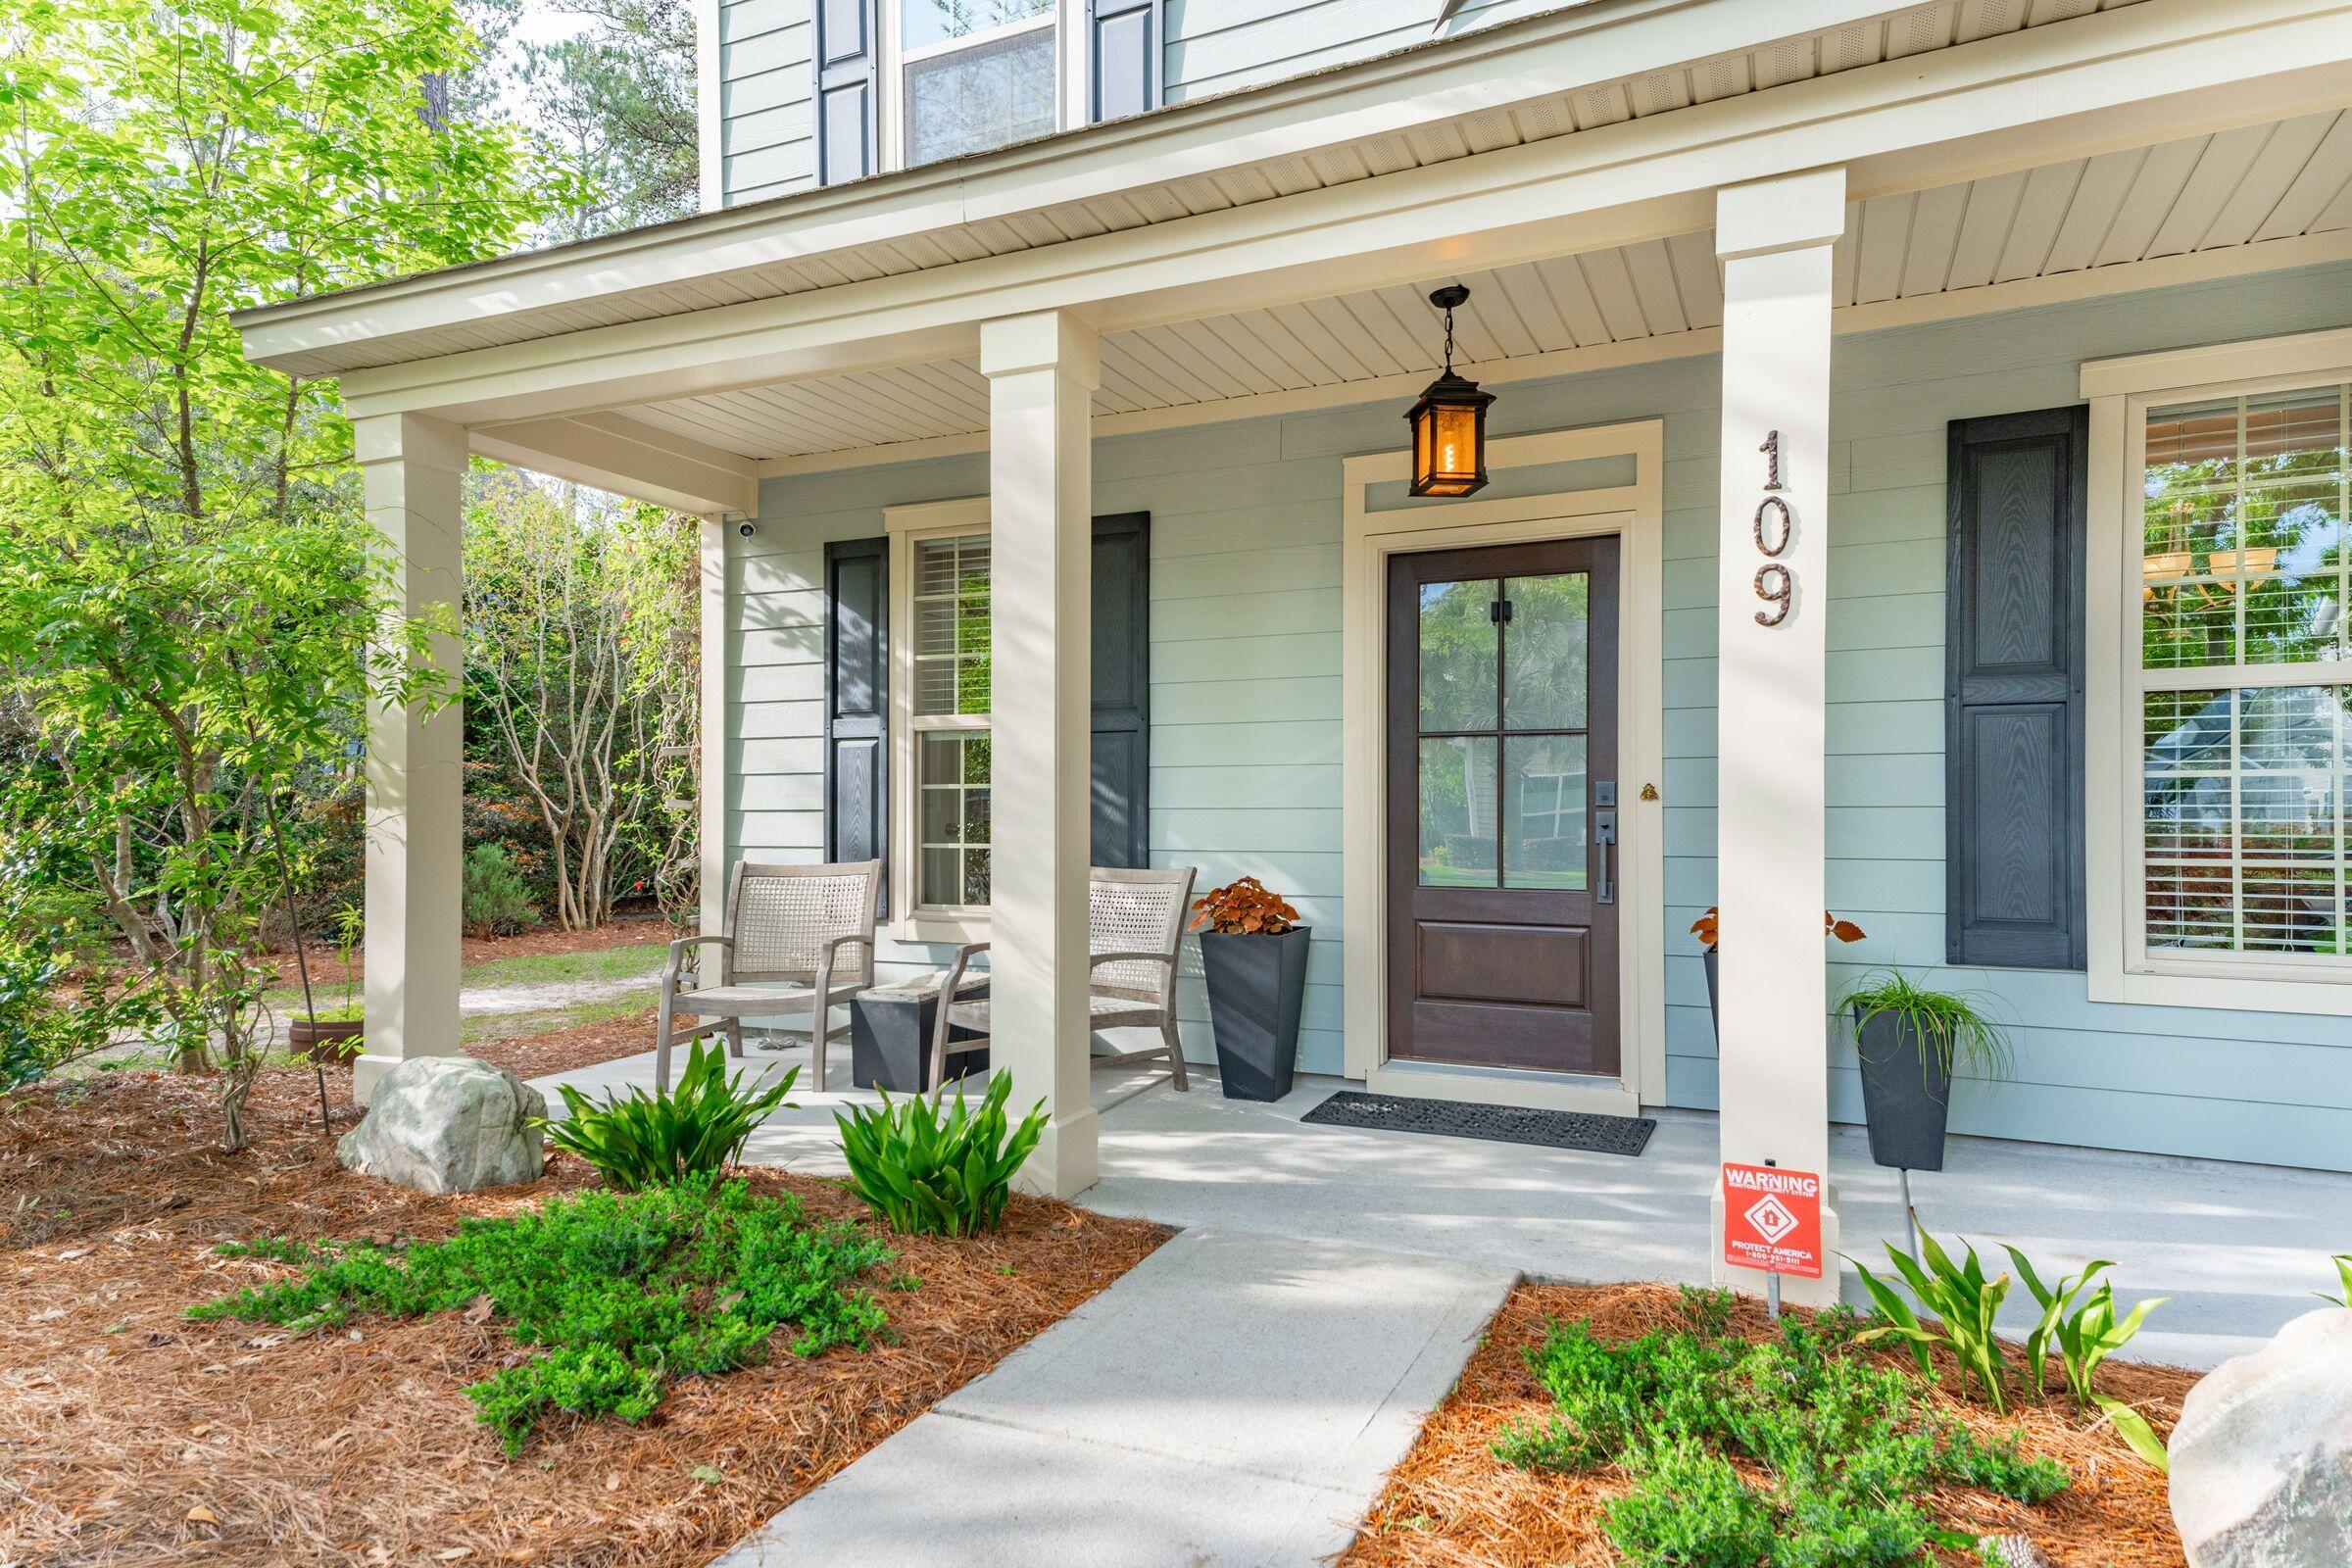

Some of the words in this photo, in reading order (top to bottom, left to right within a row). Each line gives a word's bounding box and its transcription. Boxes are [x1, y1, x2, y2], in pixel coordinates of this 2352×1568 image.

[1753, 429, 1791, 627] 109
[1725, 1168, 1817, 1193] WARNING
[1729, 1182, 1761, 1191] MONITORED
[1763, 1186, 1789, 1195] SECURITY
[1732, 1241, 1772, 1252] PROTECT
[1773, 1248, 1812, 1260] AMERICA
